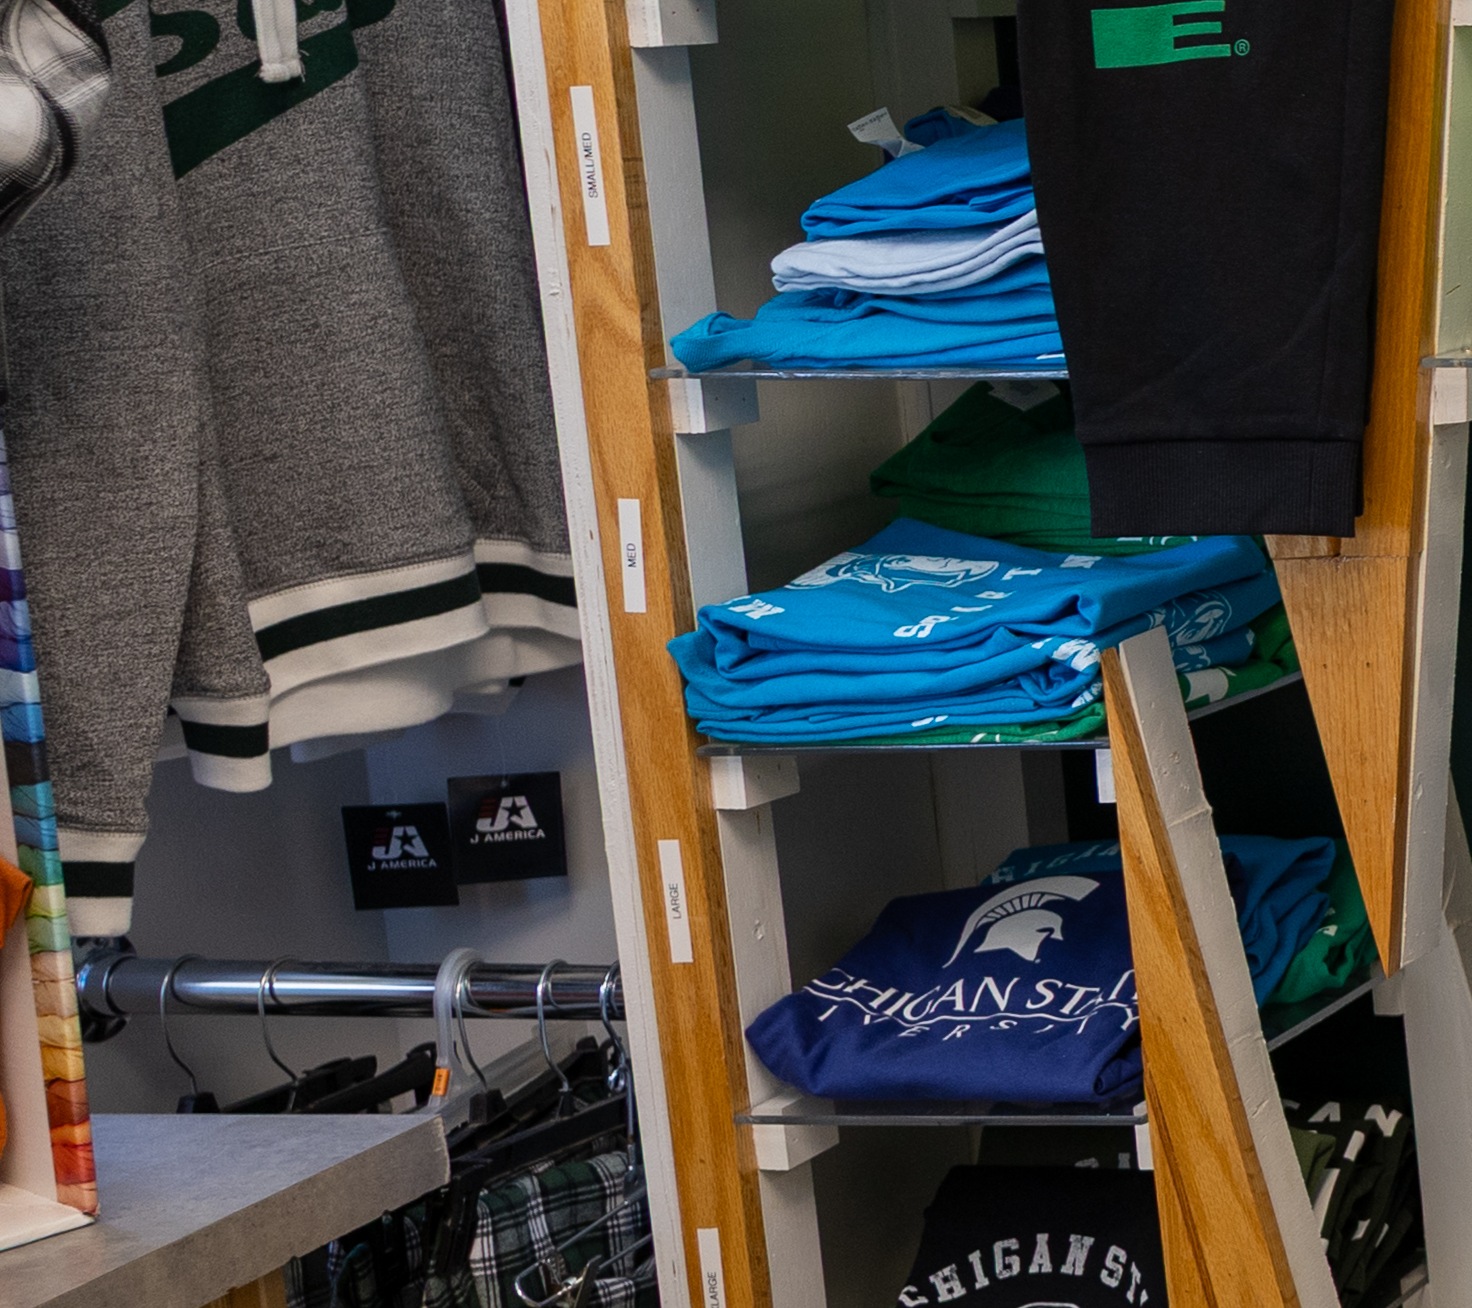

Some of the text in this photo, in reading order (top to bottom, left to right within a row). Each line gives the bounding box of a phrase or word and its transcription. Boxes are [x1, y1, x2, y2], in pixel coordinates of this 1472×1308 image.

[581, 132, 599, 199] SMALL/MED
[626, 542, 637, 568] MED
[470, 828, 546, 845] J AMERICA
[367, 858, 438, 872] J AMERICA
[668, 883, 682, 920] LARGE
